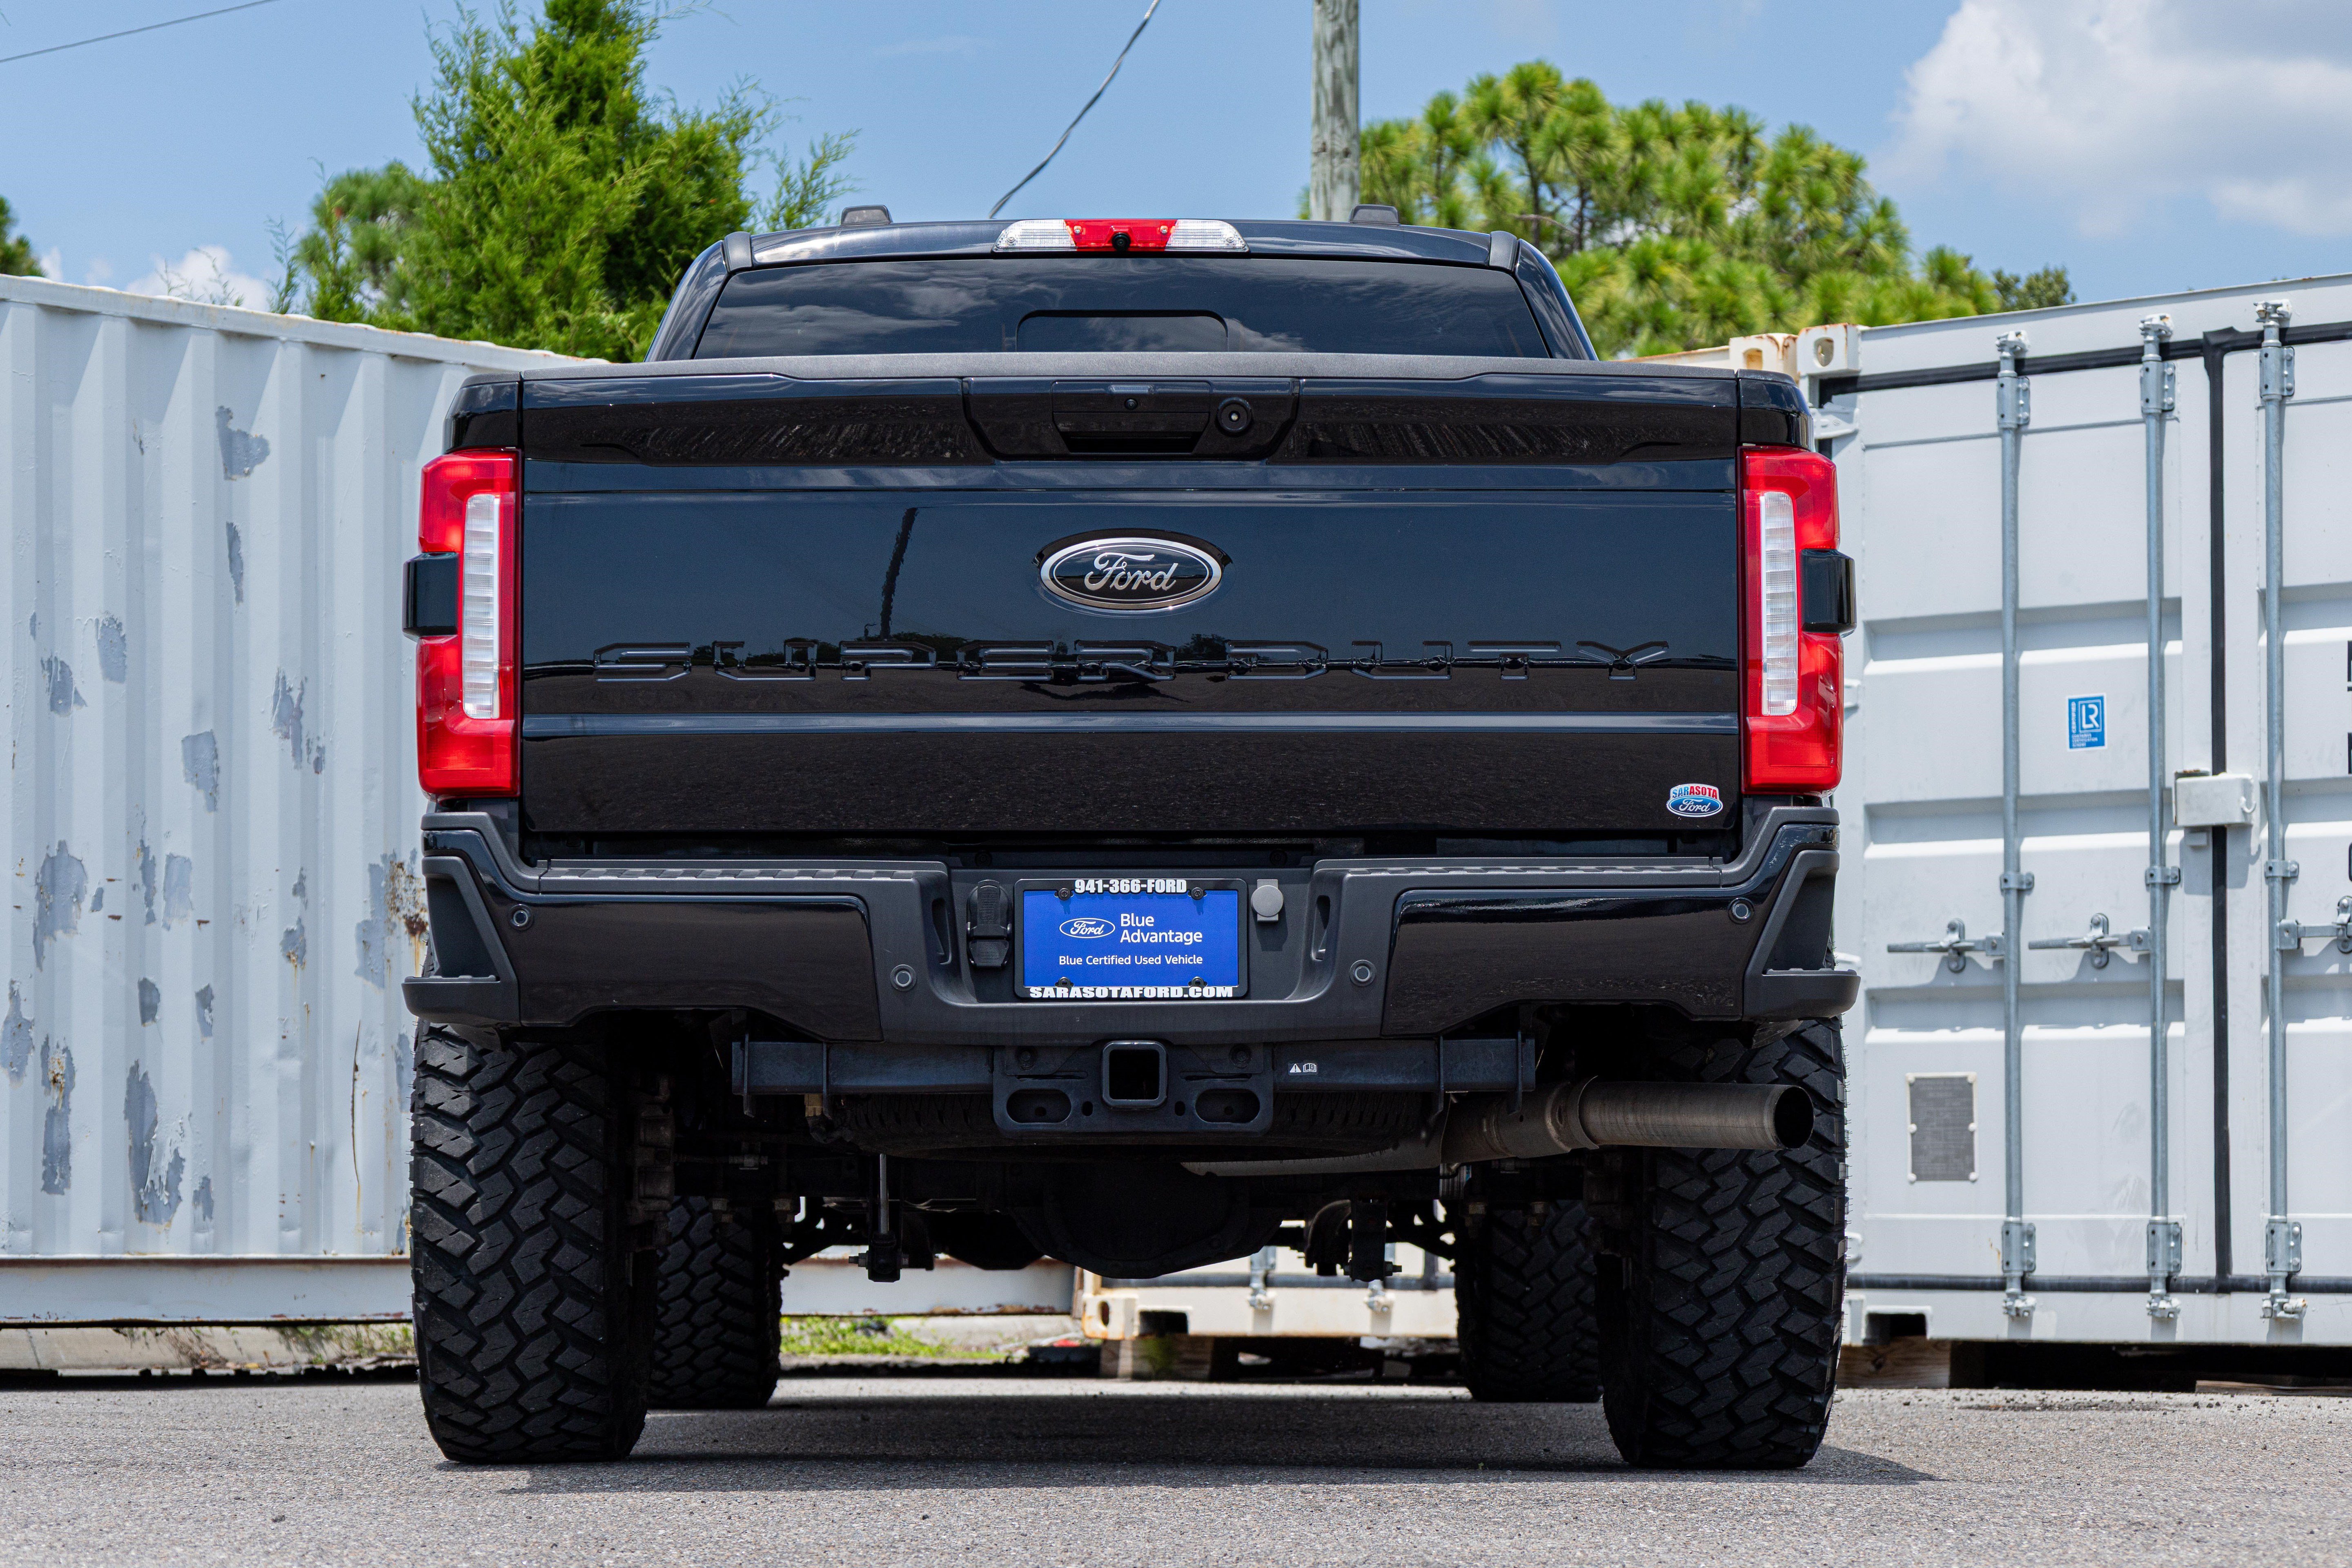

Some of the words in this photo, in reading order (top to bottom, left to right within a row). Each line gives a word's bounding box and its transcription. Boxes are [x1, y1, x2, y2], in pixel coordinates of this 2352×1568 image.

[1084, 552, 1179, 590] Ford
[593, 639, 1175, 681] SUPER
[1226, 640, 1669, 681] DUTY
[1672, 786, 1717, 800] SARASOTA
[1679, 798, 1711, 812] Ford
[1075, 879, 1187, 893] 941-366-FORD
[1120, 913, 1154, 927] Blue
[1070, 920, 1105, 935] Ford
[1120, 929, 1203, 945] Advantage
[1059, 956, 1082, 965] Blue
[1086, 955, 1131, 965] Certified
[1134, 955, 1161, 964] Used
[1165, 955, 1203, 964] Vehicle
[1030, 987, 1233, 998] SARASOTAFORD.COM
